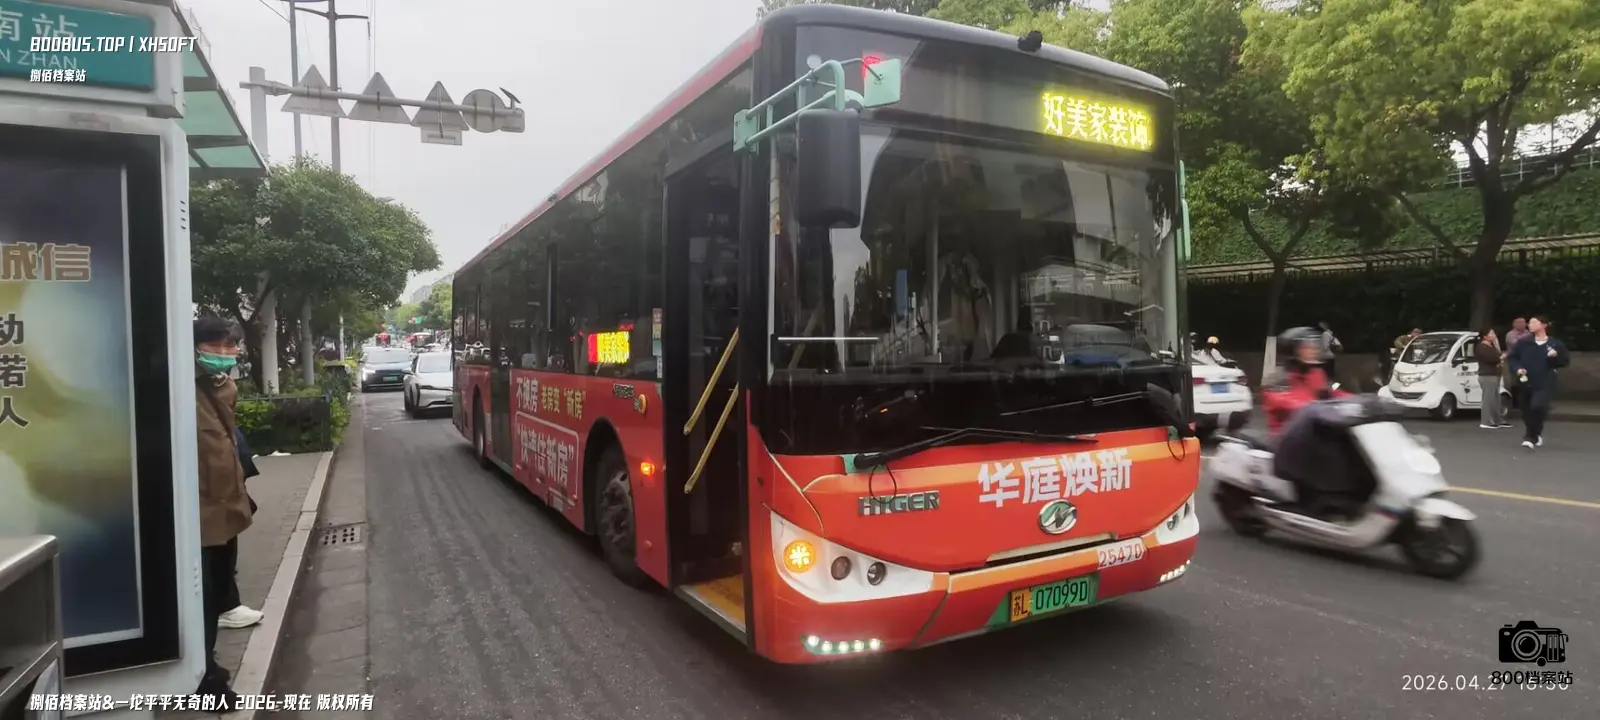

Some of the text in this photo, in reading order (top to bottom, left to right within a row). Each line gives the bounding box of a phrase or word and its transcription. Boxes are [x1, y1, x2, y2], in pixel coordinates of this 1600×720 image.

[17, 50, 78, 70] ZHAN
[978, 448, 1133, 508] 华庭焕新
[857, 490, 940, 517] HIGER
[1098, 542, 1144, 568] 25470
